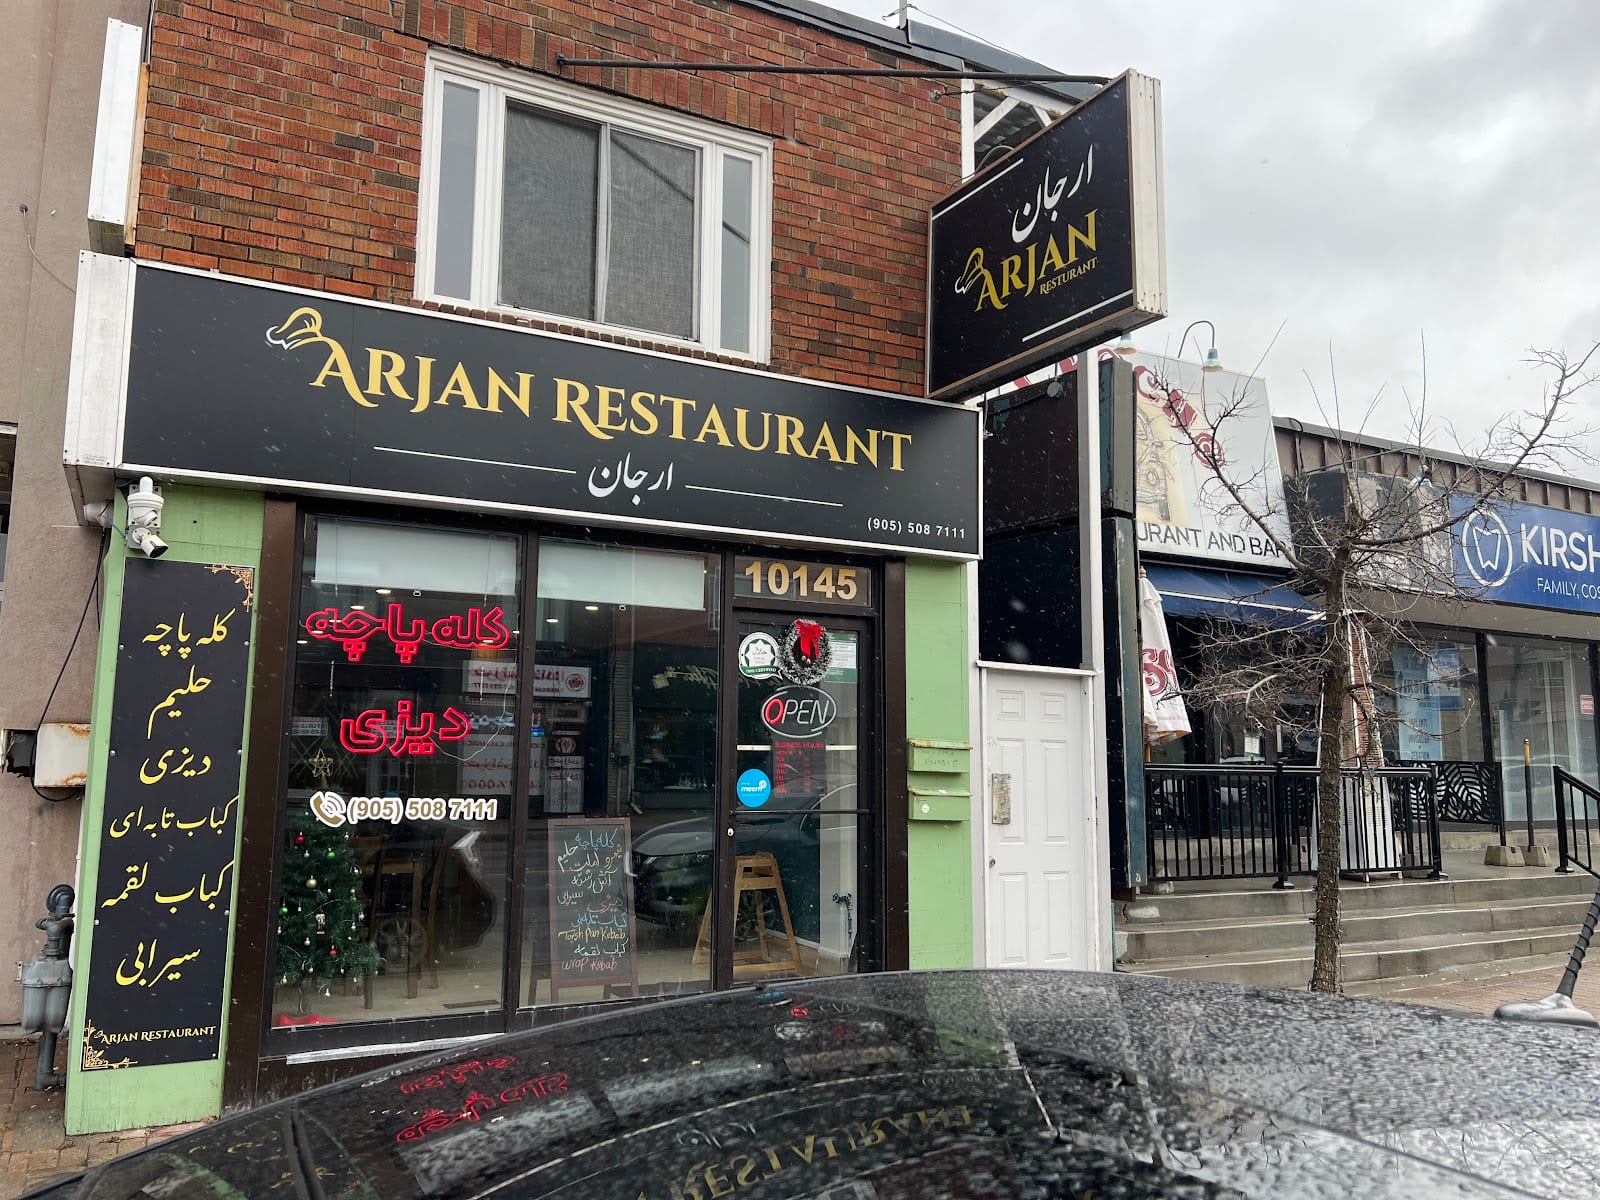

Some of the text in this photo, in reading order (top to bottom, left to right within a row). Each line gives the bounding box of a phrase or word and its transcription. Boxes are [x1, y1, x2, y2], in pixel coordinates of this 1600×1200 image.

[1011, 143, 1093, 243] ارجان
[974, 209, 1098, 312] ARJAN
[1039, 256, 1098, 295] RESTURANT
[309, 336, 912, 471] ARJAN RESTAURANT
[588, 452, 673, 506] ارجان
[867, 517, 966, 539] (905) 508 7111
[1208, 531, 1245, 553] AND
[745, 561, 857, 600] 10145
[1537, 577, 1579, 599] FAMILY,
[142, 608, 236, 659] کله پاچه
[305, 603, 510, 664] کله پاچه
[148, 664, 212, 739] حلیم
[764, 698, 830, 725] OPEN
[340, 700, 471, 756] دیزی
[139, 747, 212, 785] دیزی
[176, 795, 239, 838] کباب
[347, 797, 498, 824] (905) 508 7111
[155, 859, 236, 913] کباب
[115, 939, 200, 987] سیرابی
[100, 1025, 217, 1045] ARJAN RESTAURANT
